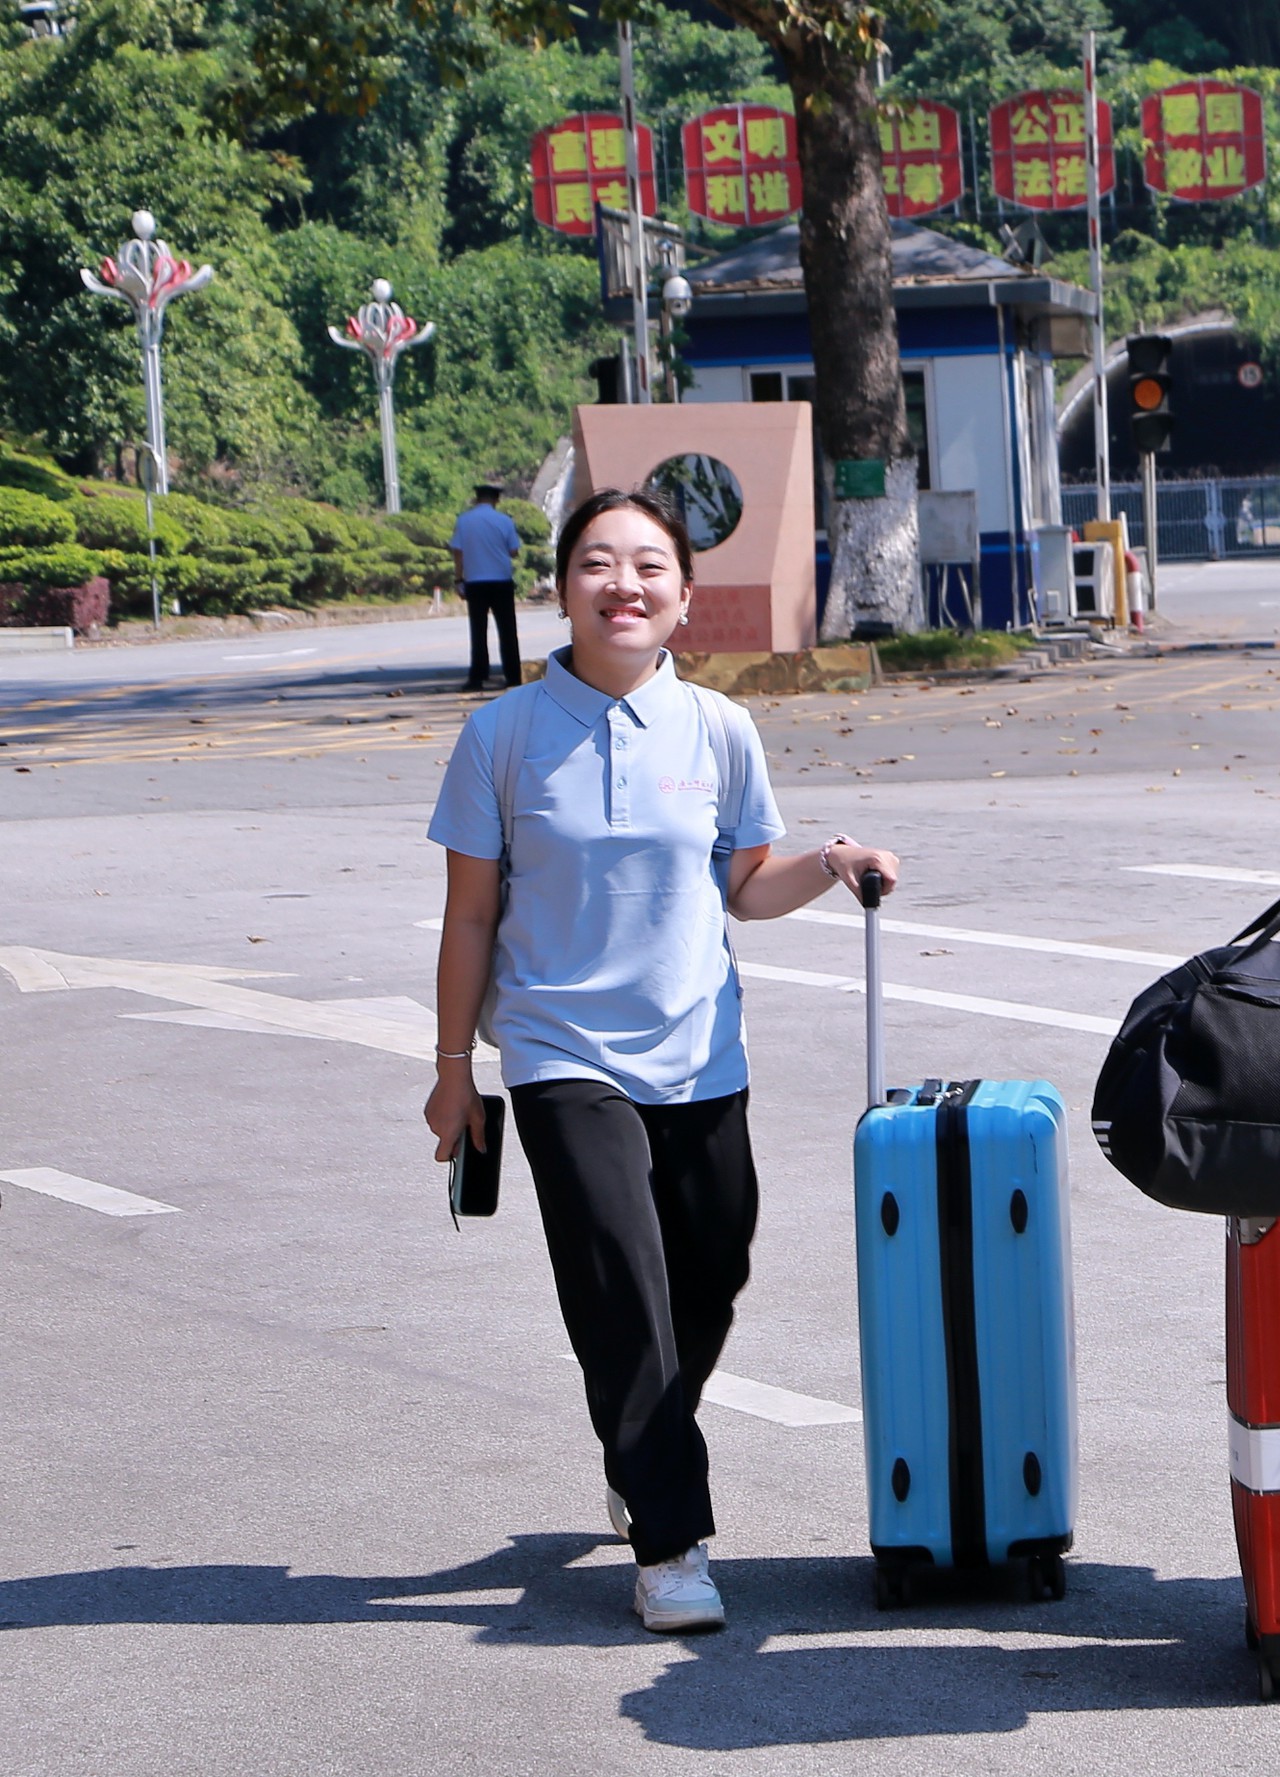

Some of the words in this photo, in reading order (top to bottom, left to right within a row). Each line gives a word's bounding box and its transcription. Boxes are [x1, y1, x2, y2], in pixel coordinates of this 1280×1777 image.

[1010, 104, 1087, 144] 公正
[1162, 92, 1243, 135] 爱国
[702, 117, 787, 163] 文明
[1014, 156, 1088, 197] 法治
[1165, 147, 1246, 188] 敬业
[706, 170, 790, 215] 和谐
